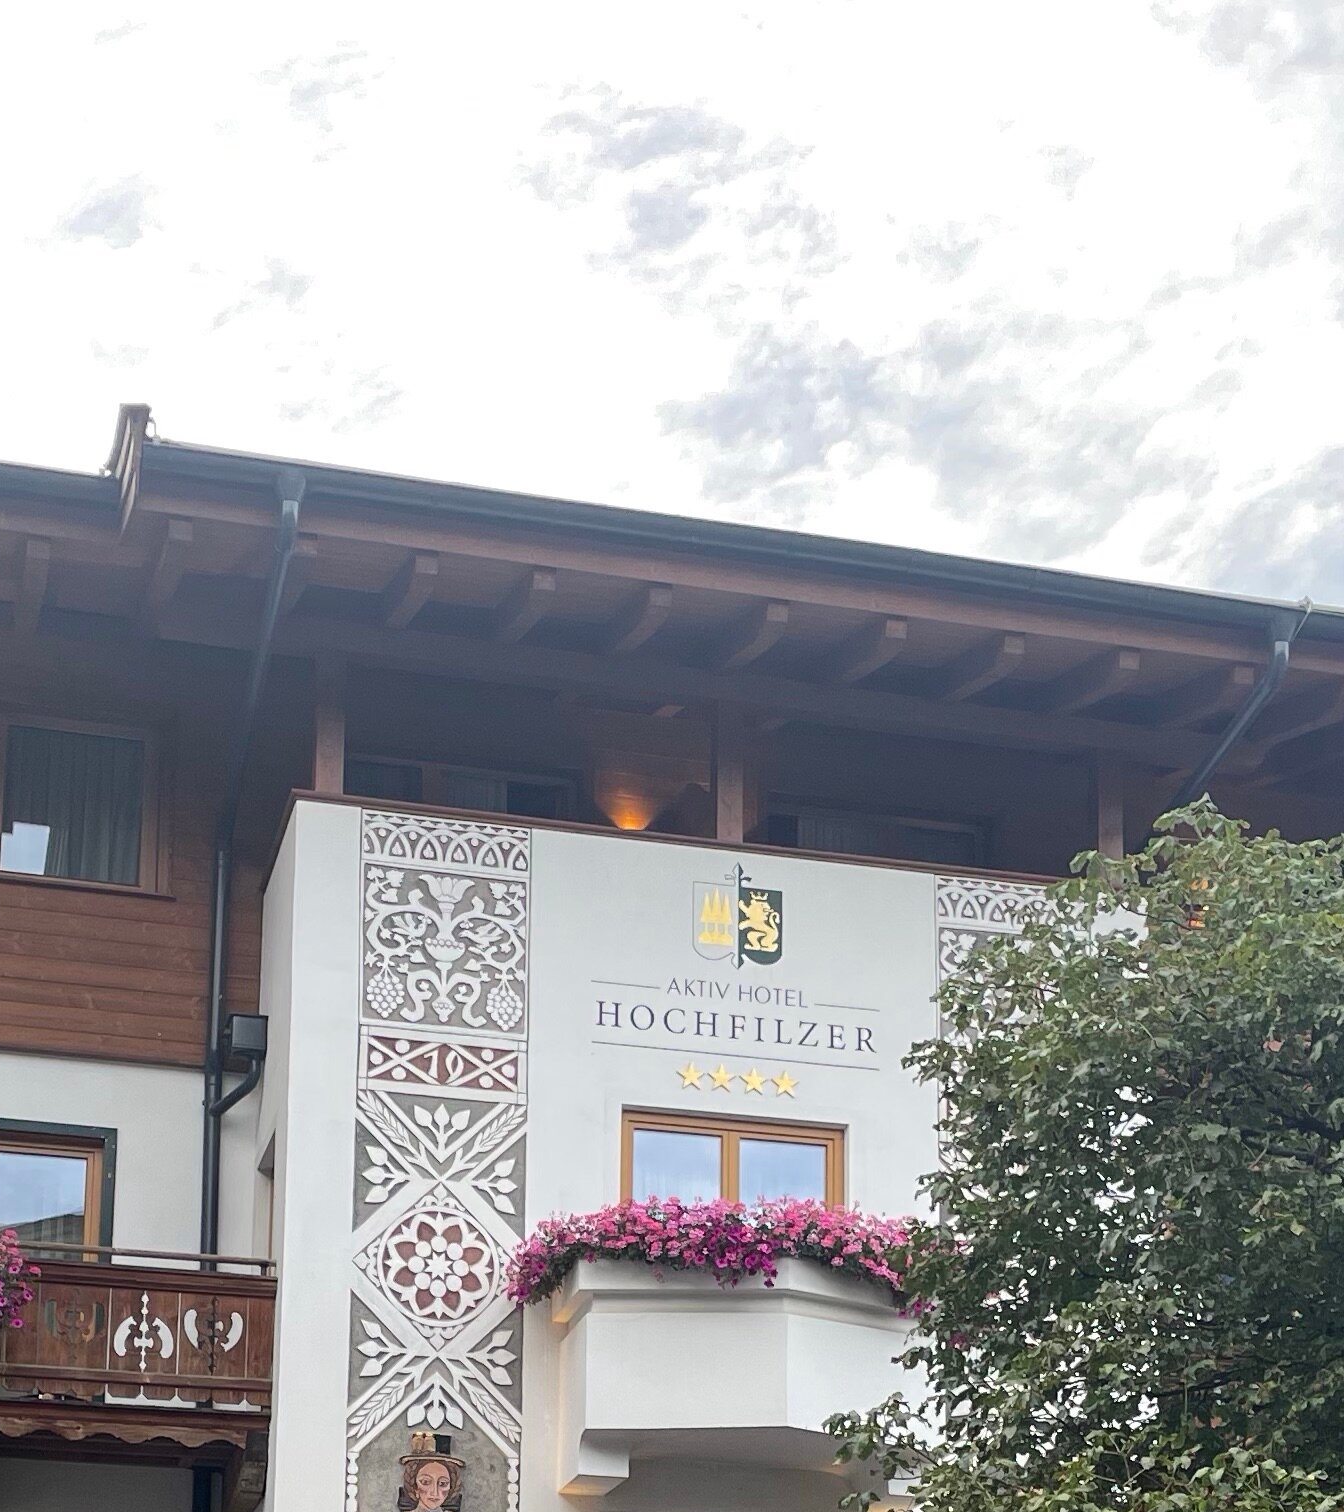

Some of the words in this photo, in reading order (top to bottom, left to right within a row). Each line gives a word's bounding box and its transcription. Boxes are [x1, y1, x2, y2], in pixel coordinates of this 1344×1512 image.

[666, 977, 730, 999] AKTIV
[738, 984, 808, 1009] HOTEL
[595, 1000, 877, 1053] HOCHFILZER
